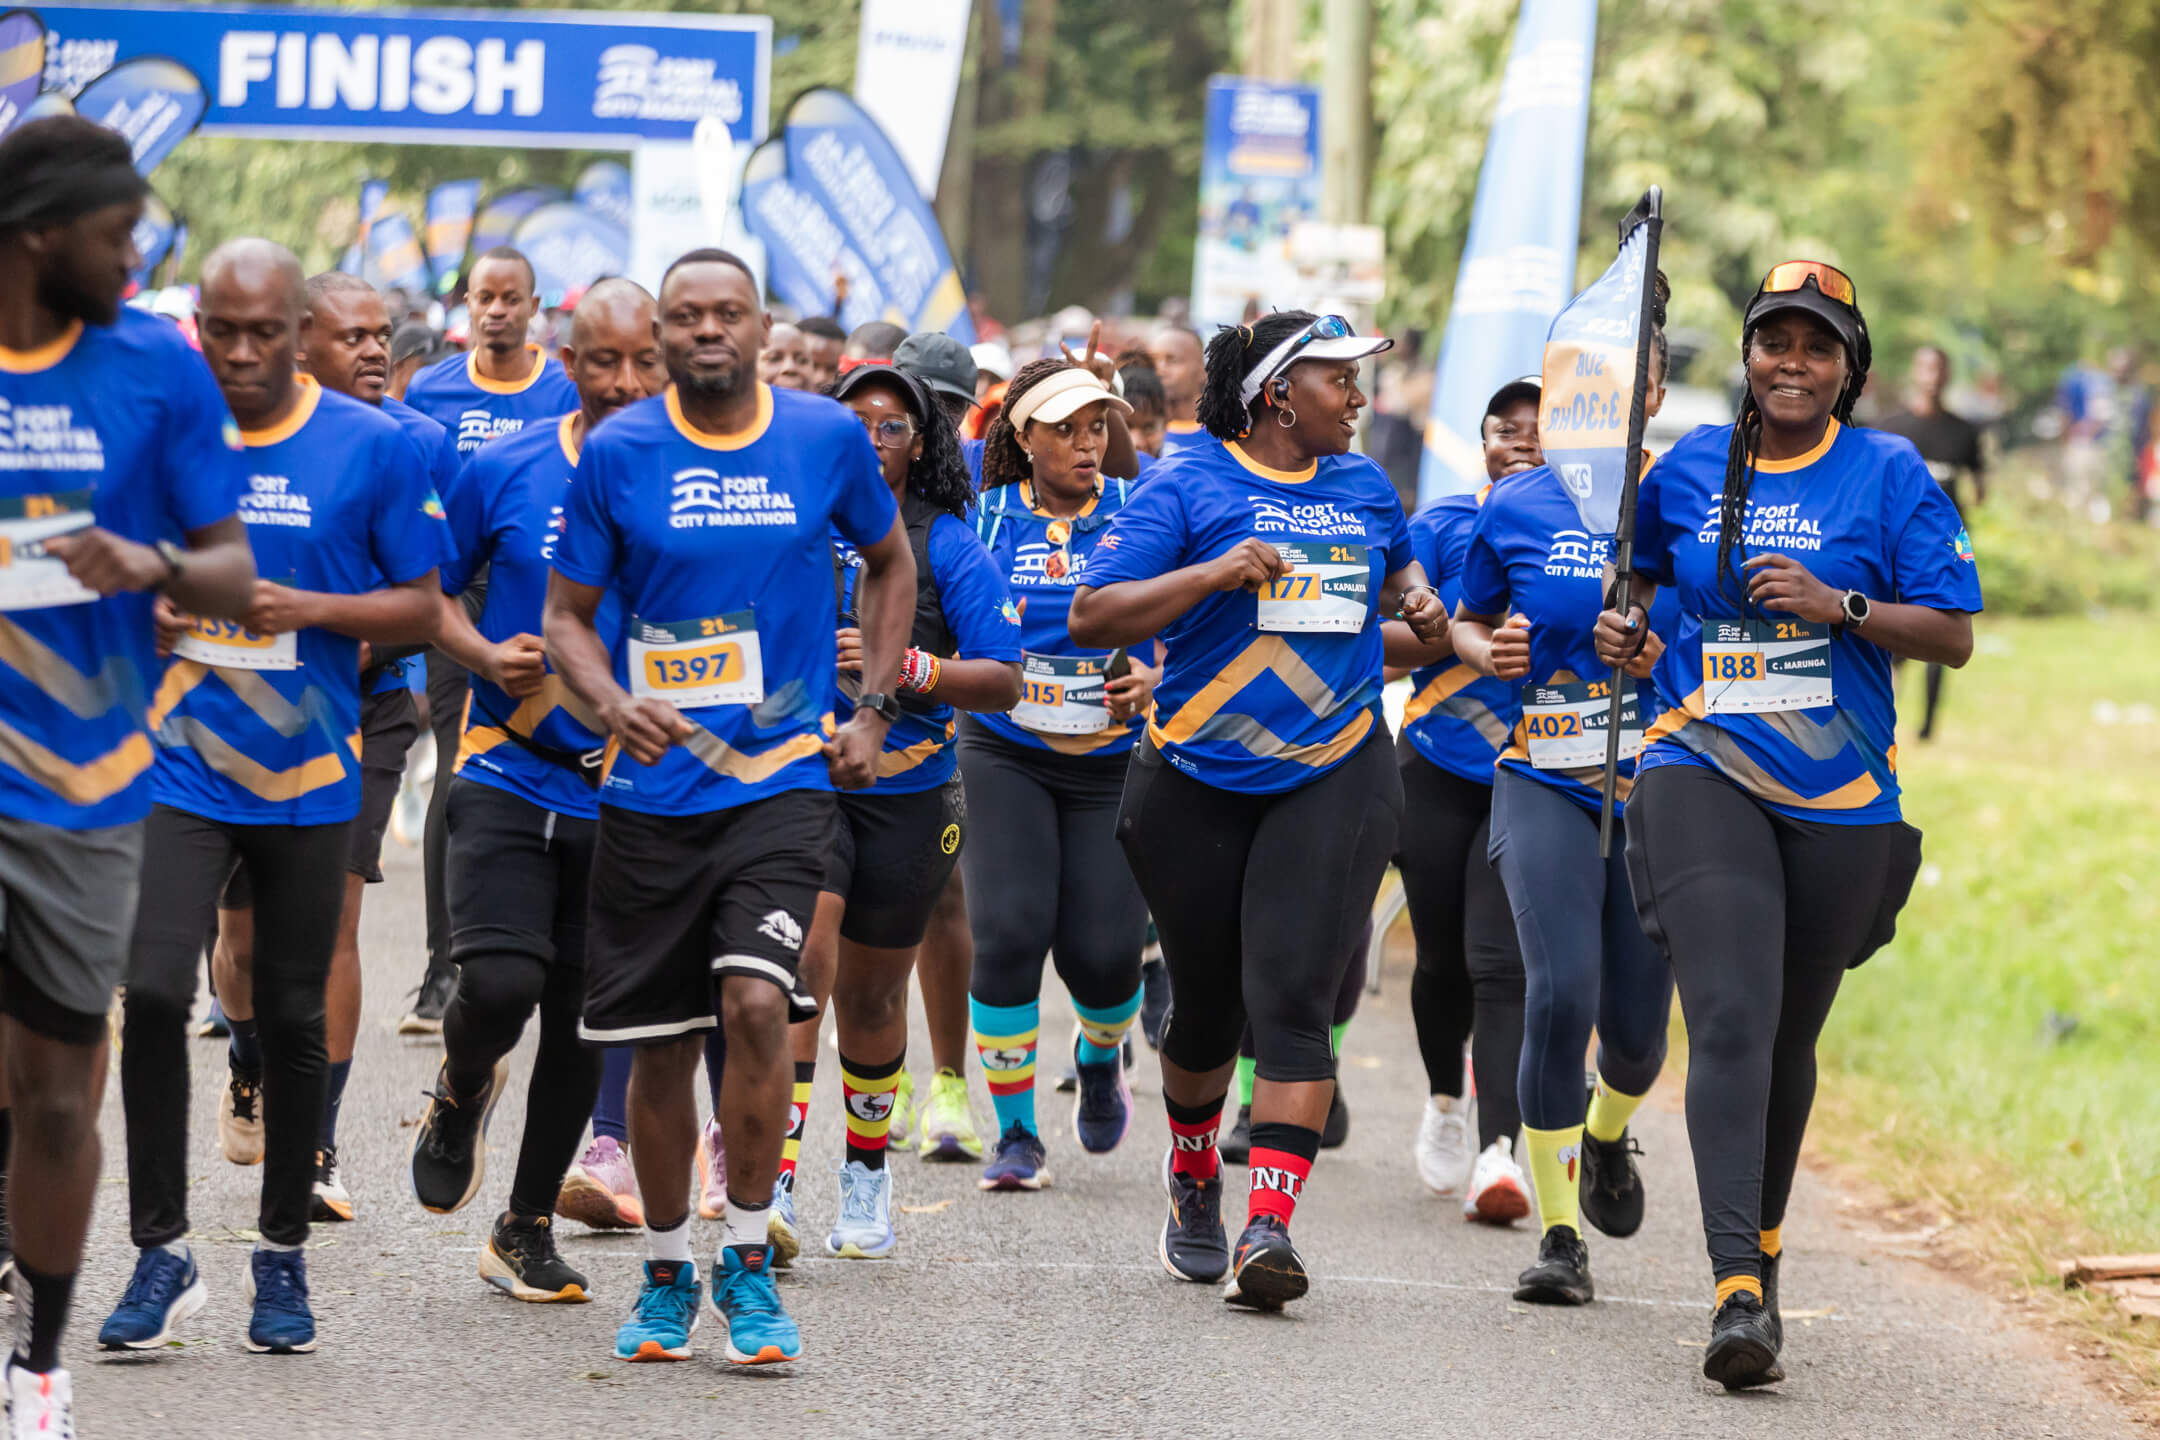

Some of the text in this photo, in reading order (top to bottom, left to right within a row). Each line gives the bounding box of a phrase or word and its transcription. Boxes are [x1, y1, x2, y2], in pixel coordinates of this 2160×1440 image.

[219, 30, 545, 117] FINISH
[493, 418, 524, 432] FORT
[248, 474, 290, 493] ORT
[722, 476, 768, 493] FORT
[723, 493, 795, 510] PORTAL
[1292, 503, 1334, 519] FORT
[1754, 504, 1799, 519] FORT
[670, 511, 797, 529] CITY MARATHON
[1297, 512, 1362, 529] PORTAL
[1752, 518, 1822, 535] PORTAL
[1254, 521, 1366, 537] CITY MARATHON
[1698, 531, 1821, 551] CIT ARATHON
[1010, 573, 1038, 584] CITY
[1544, 565, 1571, 577] CITY
[1270, 576, 1313, 599] 177
[1324, 583, 1333, 592] R.
[1776, 623, 1809, 639] 21km
[654, 652, 729, 683] 1397
[1708, 655, 1757, 680] 188
[1784, 658, 1826, 670] MARUNGA
[1528, 715, 1578, 737] 402
[1584, 717, 1596, 728] N.
